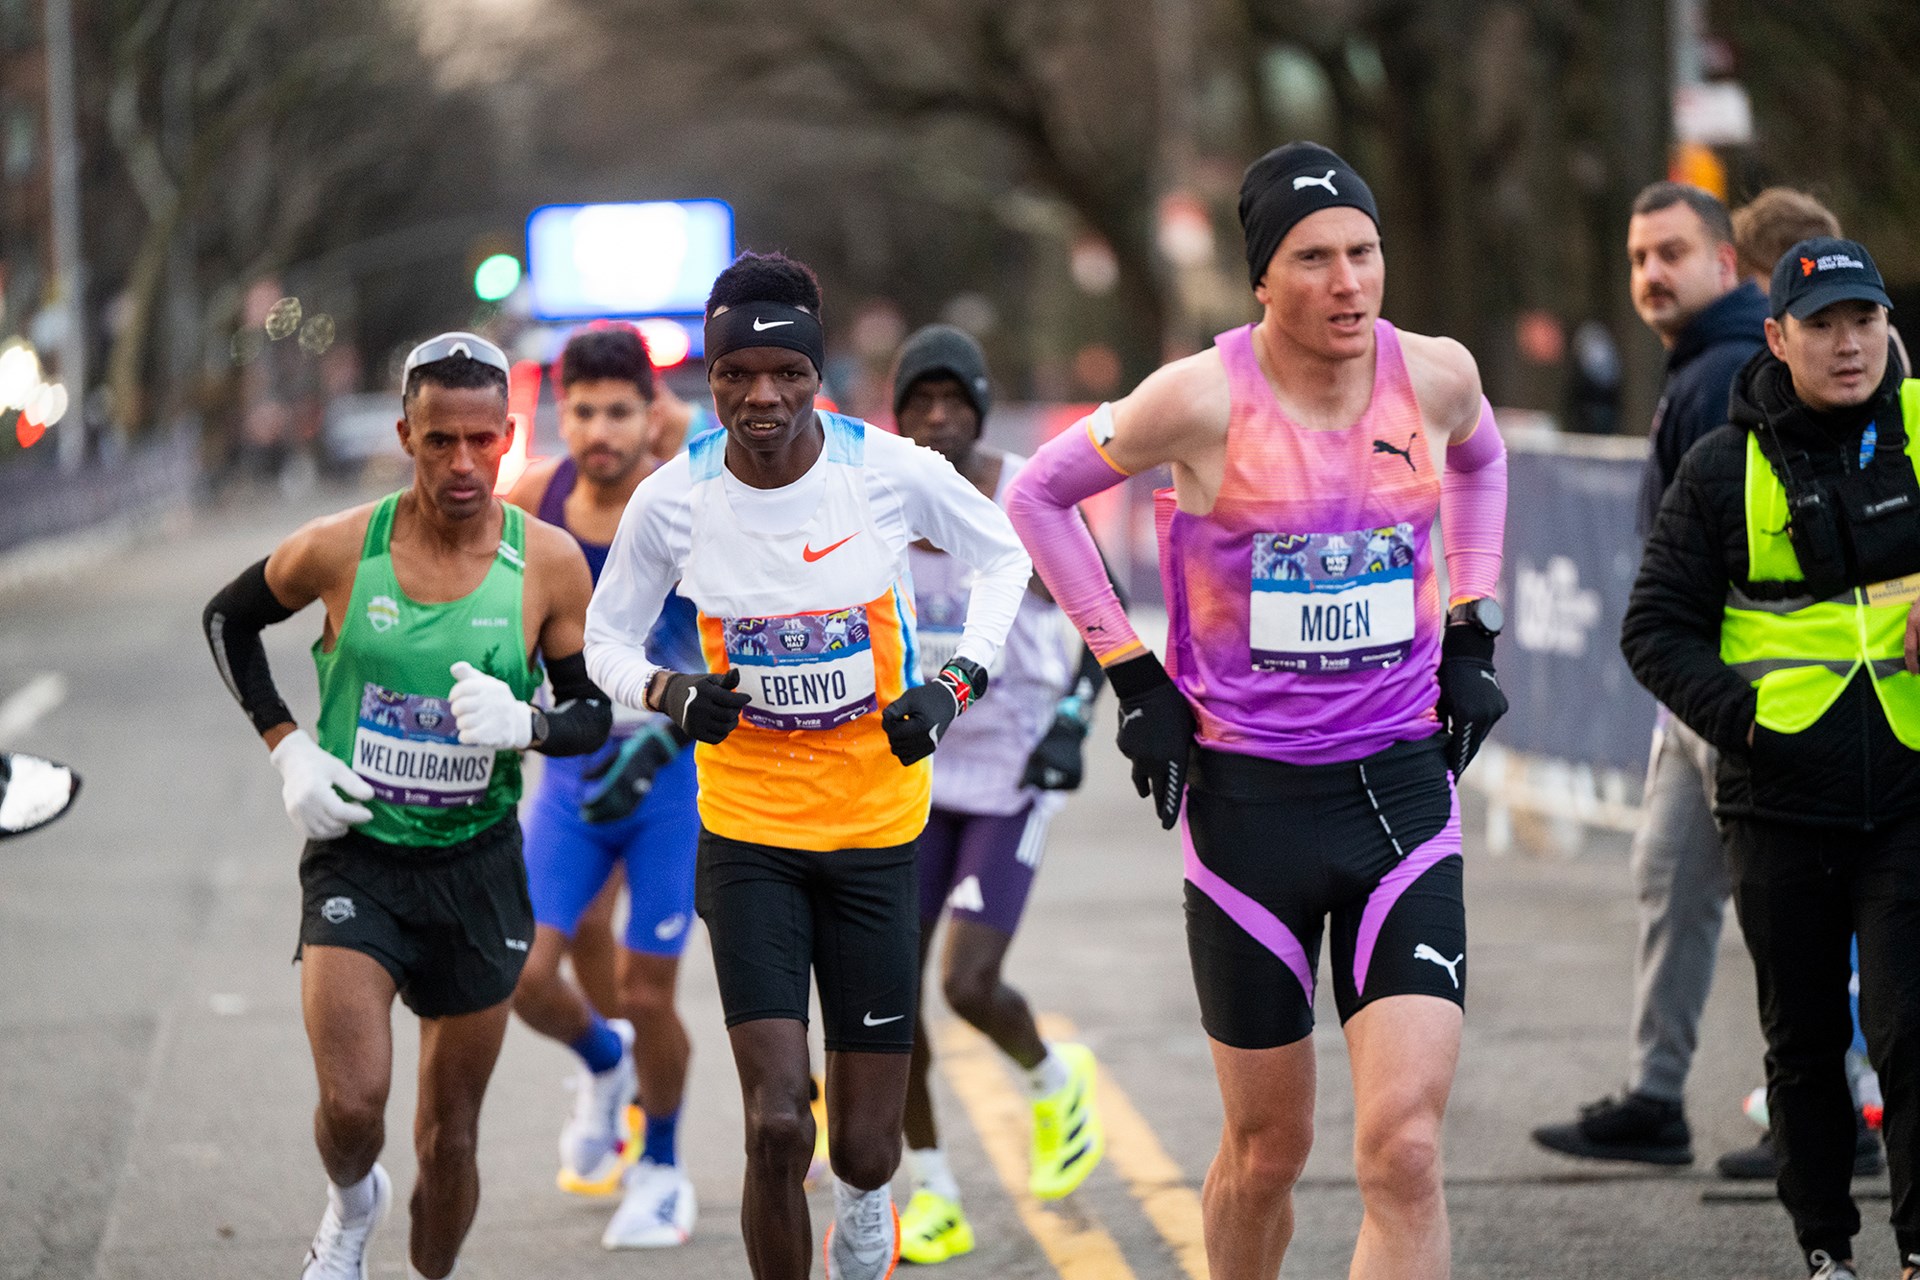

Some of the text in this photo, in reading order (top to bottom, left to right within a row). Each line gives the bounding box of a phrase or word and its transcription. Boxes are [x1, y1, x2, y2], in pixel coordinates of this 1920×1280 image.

[784, 634, 805, 643] NYC
[1301, 599, 1370, 641] MOEN
[760, 669, 846, 706] EBENYO
[360, 738, 489, 782] WELDLIBANOS
